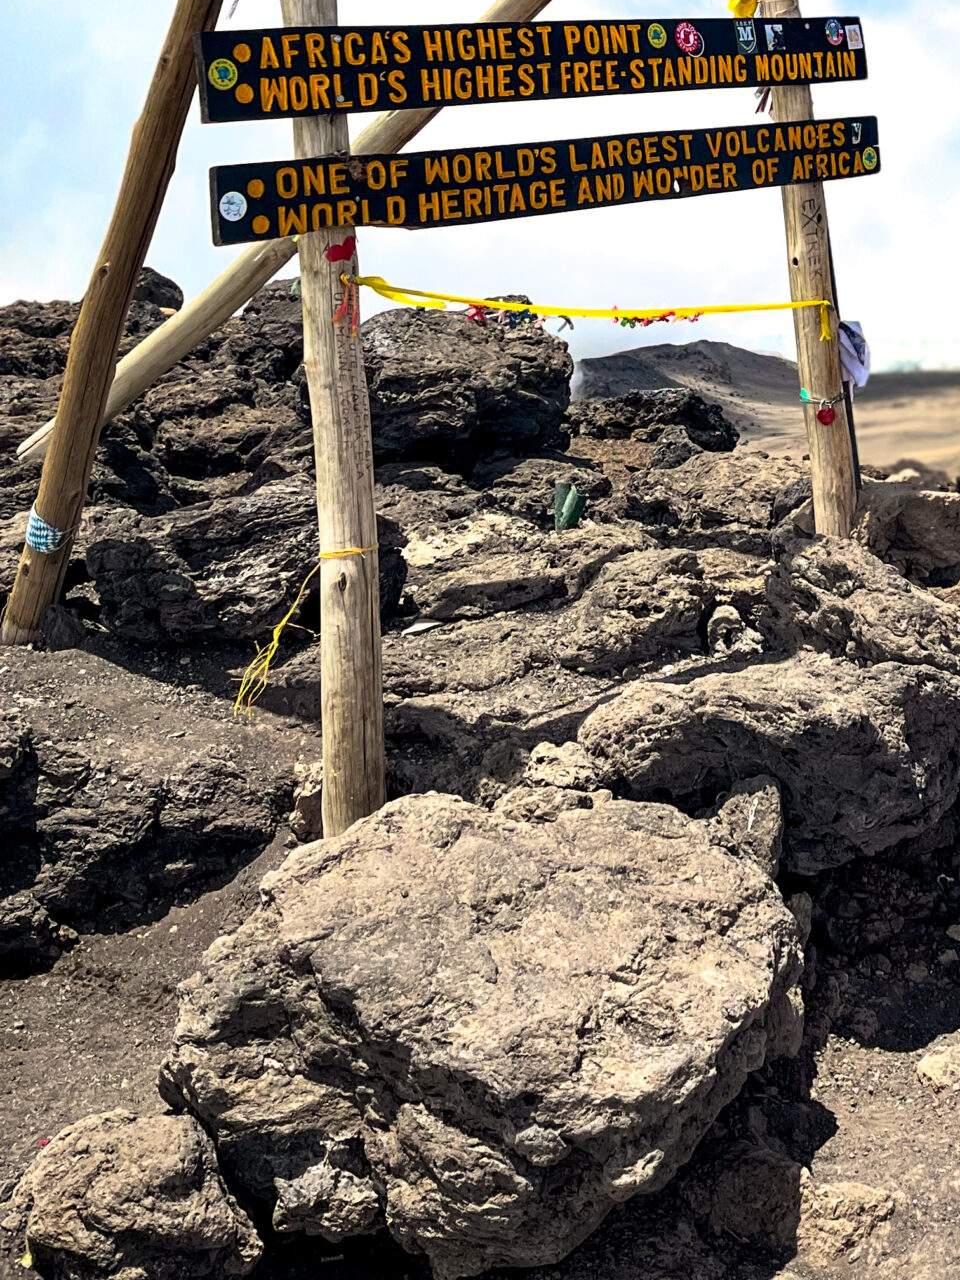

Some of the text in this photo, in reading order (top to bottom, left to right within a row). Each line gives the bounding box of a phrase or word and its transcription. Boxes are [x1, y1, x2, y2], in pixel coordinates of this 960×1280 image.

[260, 30, 411, 69] AFRICA'S
[423, 26, 552, 62] HIGHEST
[563, 24, 641, 56] POINT
[260, 70, 407, 112] WORLD'S
[421, 63, 551, 101] HIGHEST
[755, 50, 857, 82] MOUNTAIN
[276, 163, 350, 199] ONE
[367, 159, 409, 191] OF
[425, 147, 557, 185] WORLD'S
[568, 134, 693, 172] LARGEST
[705, 121, 846, 158] VOLCANOES
[278, 195, 406, 237] WORLD
[418, 178, 566, 223] HERITAGE
[577, 173, 626, 204] AND
[752, 157, 779, 186] OF
[793, 151, 865, 181] AFRICA
